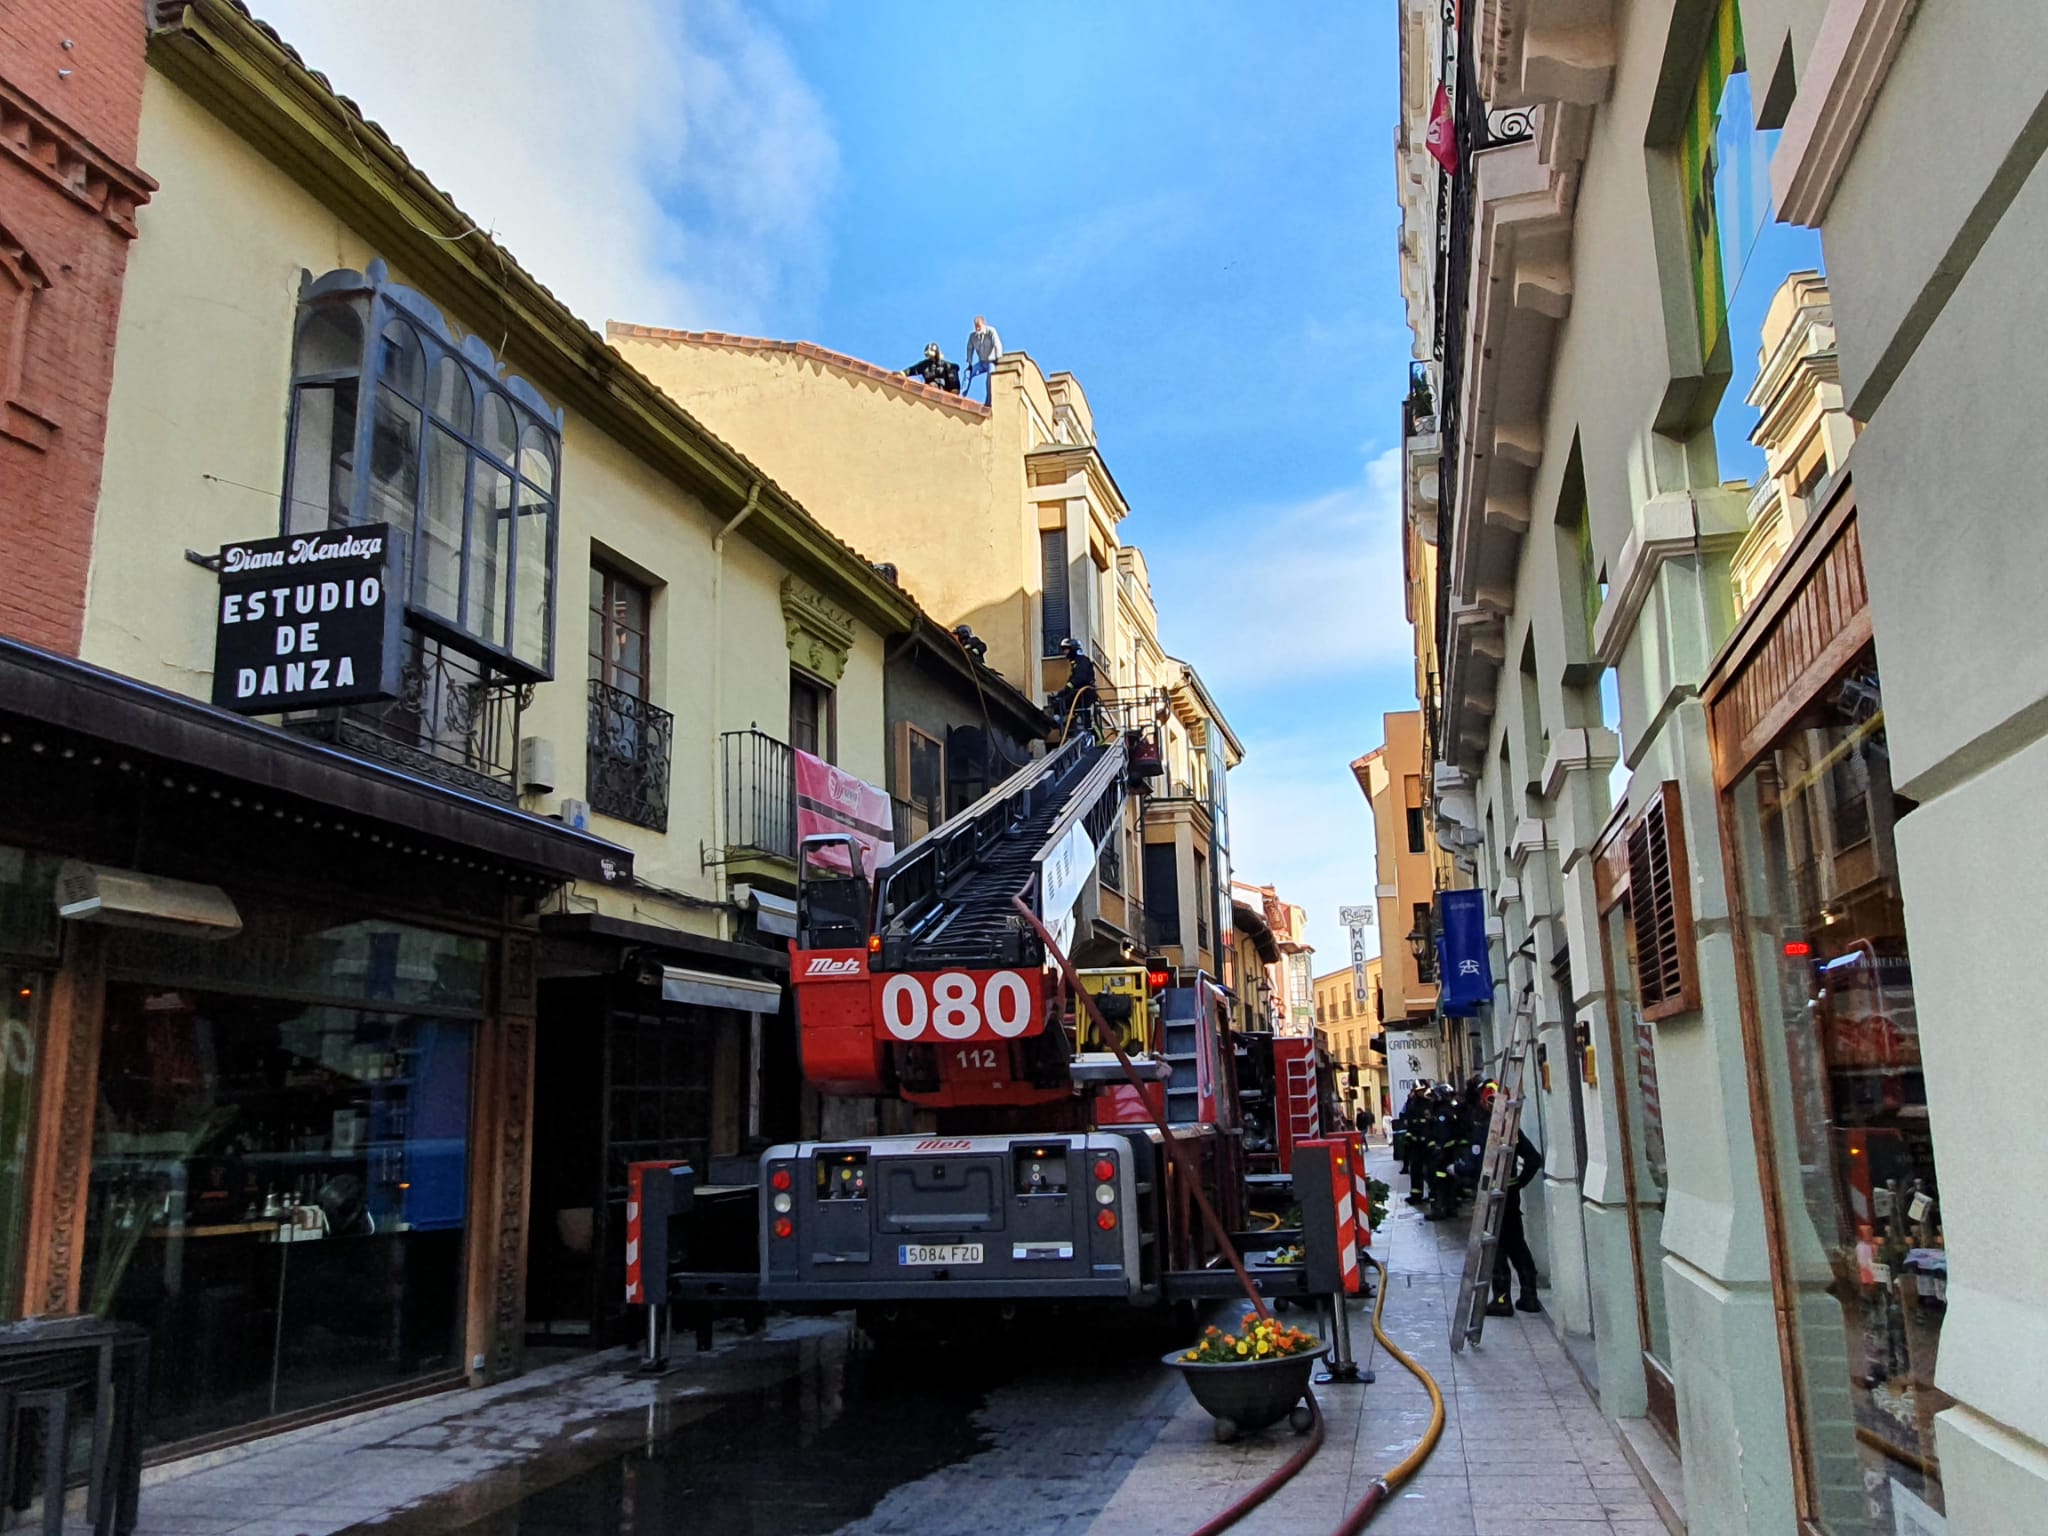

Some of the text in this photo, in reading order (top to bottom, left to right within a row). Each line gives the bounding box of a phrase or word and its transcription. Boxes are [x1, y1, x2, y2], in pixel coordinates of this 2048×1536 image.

[223, 535, 382, 572] Diana Mendoza
[223, 577, 380, 624] ESTUDIO
[276, 622, 320, 655] DE
[237, 656, 355, 698] DANZA
[805, 957, 861, 976] Metz
[1351, 927, 1366, 999] MADRID
[882, 970, 1031, 1041] 080
[956, 1049, 997, 1068] 112
[909, 1247, 946, 1262] 5084
